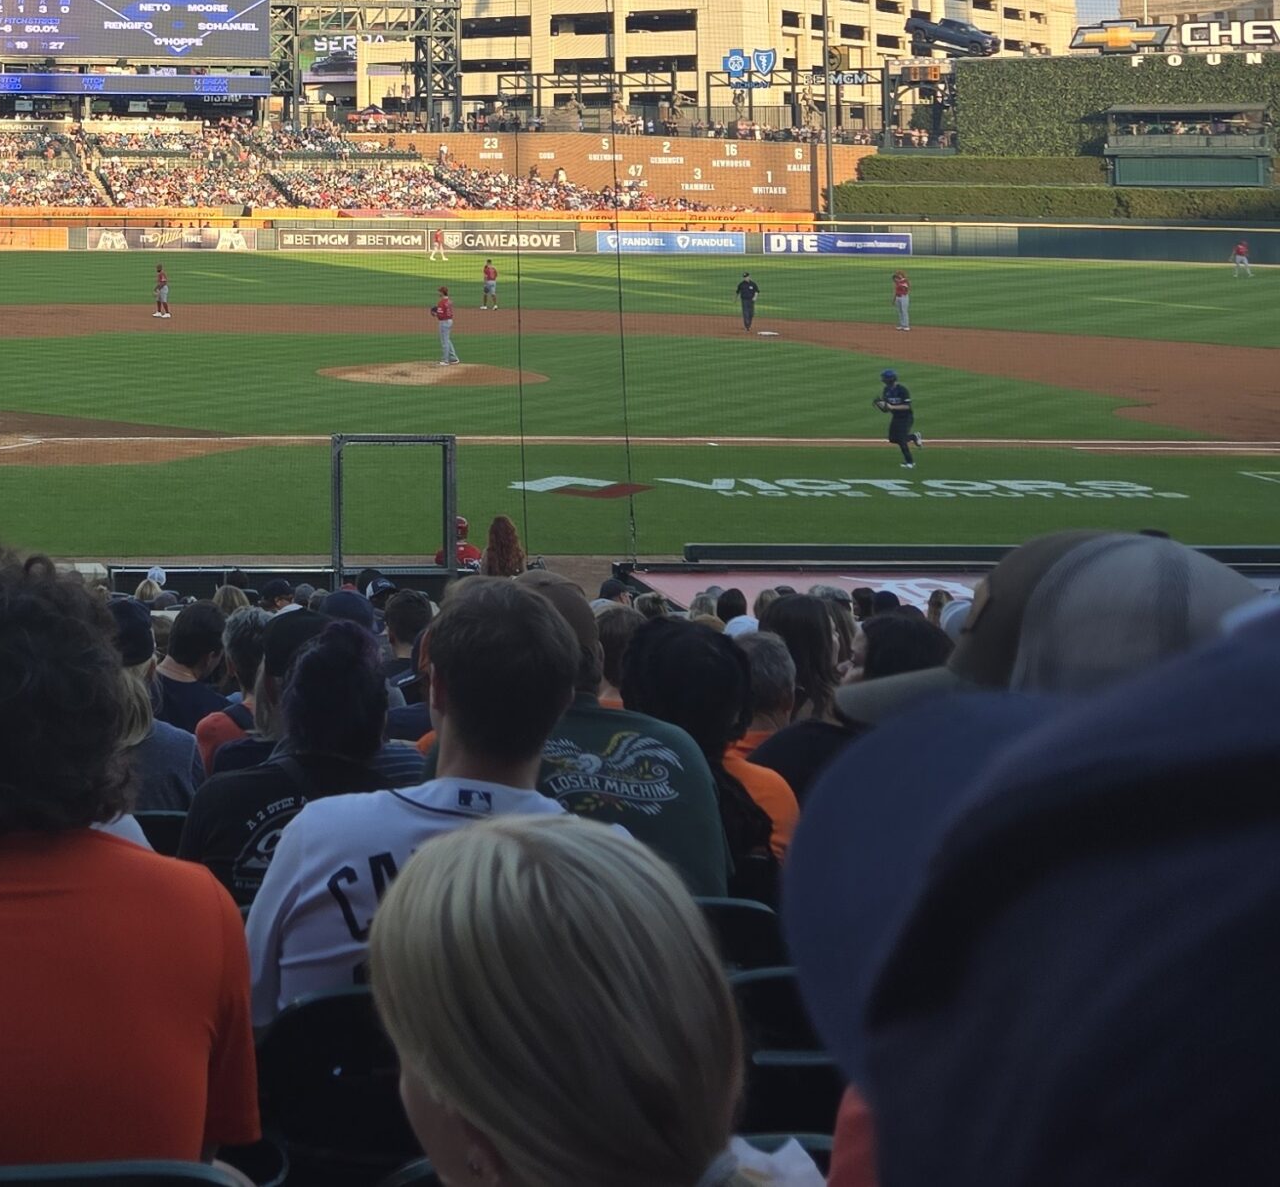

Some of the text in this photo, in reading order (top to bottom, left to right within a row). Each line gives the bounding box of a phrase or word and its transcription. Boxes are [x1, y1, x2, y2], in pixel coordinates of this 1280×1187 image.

[39, 5, 48, 13] 3
[60, 5, 70, 13] 0
[139, 3, 171, 12] NETO
[187, 4, 228, 12] MOORE
[104, 21, 153, 30] RENGIFO
[198, 22, 259, 31] SCHANUEL
[49, 41, 65, 49] 27
[154, 38, 203, 46] O'HOPPE
[803, 73, 869, 85] BEMGM
[483, 137, 498, 149] 23
[601, 138, 609, 150] 5
[662, 141, 671, 153] 2
[725, 144, 738, 156] 16
[794, 148, 803, 160] 6
[628, 165, 643, 176] 47
[693, 168, 702, 180] 3
[766, 171, 772, 183] 1
[295, 234, 349, 245] BETMGM
[367, 234, 422, 246] BETMGM
[464, 234, 561, 247] GAMEABOVE
[622, 237, 666, 247] FANDUEL
[691, 237, 735, 247] FANDUEL
[770, 234, 818, 253] DTE
[654, 478, 1153, 491] VICTORS
[549, 774, 675, 797] LOSER MACHINE
